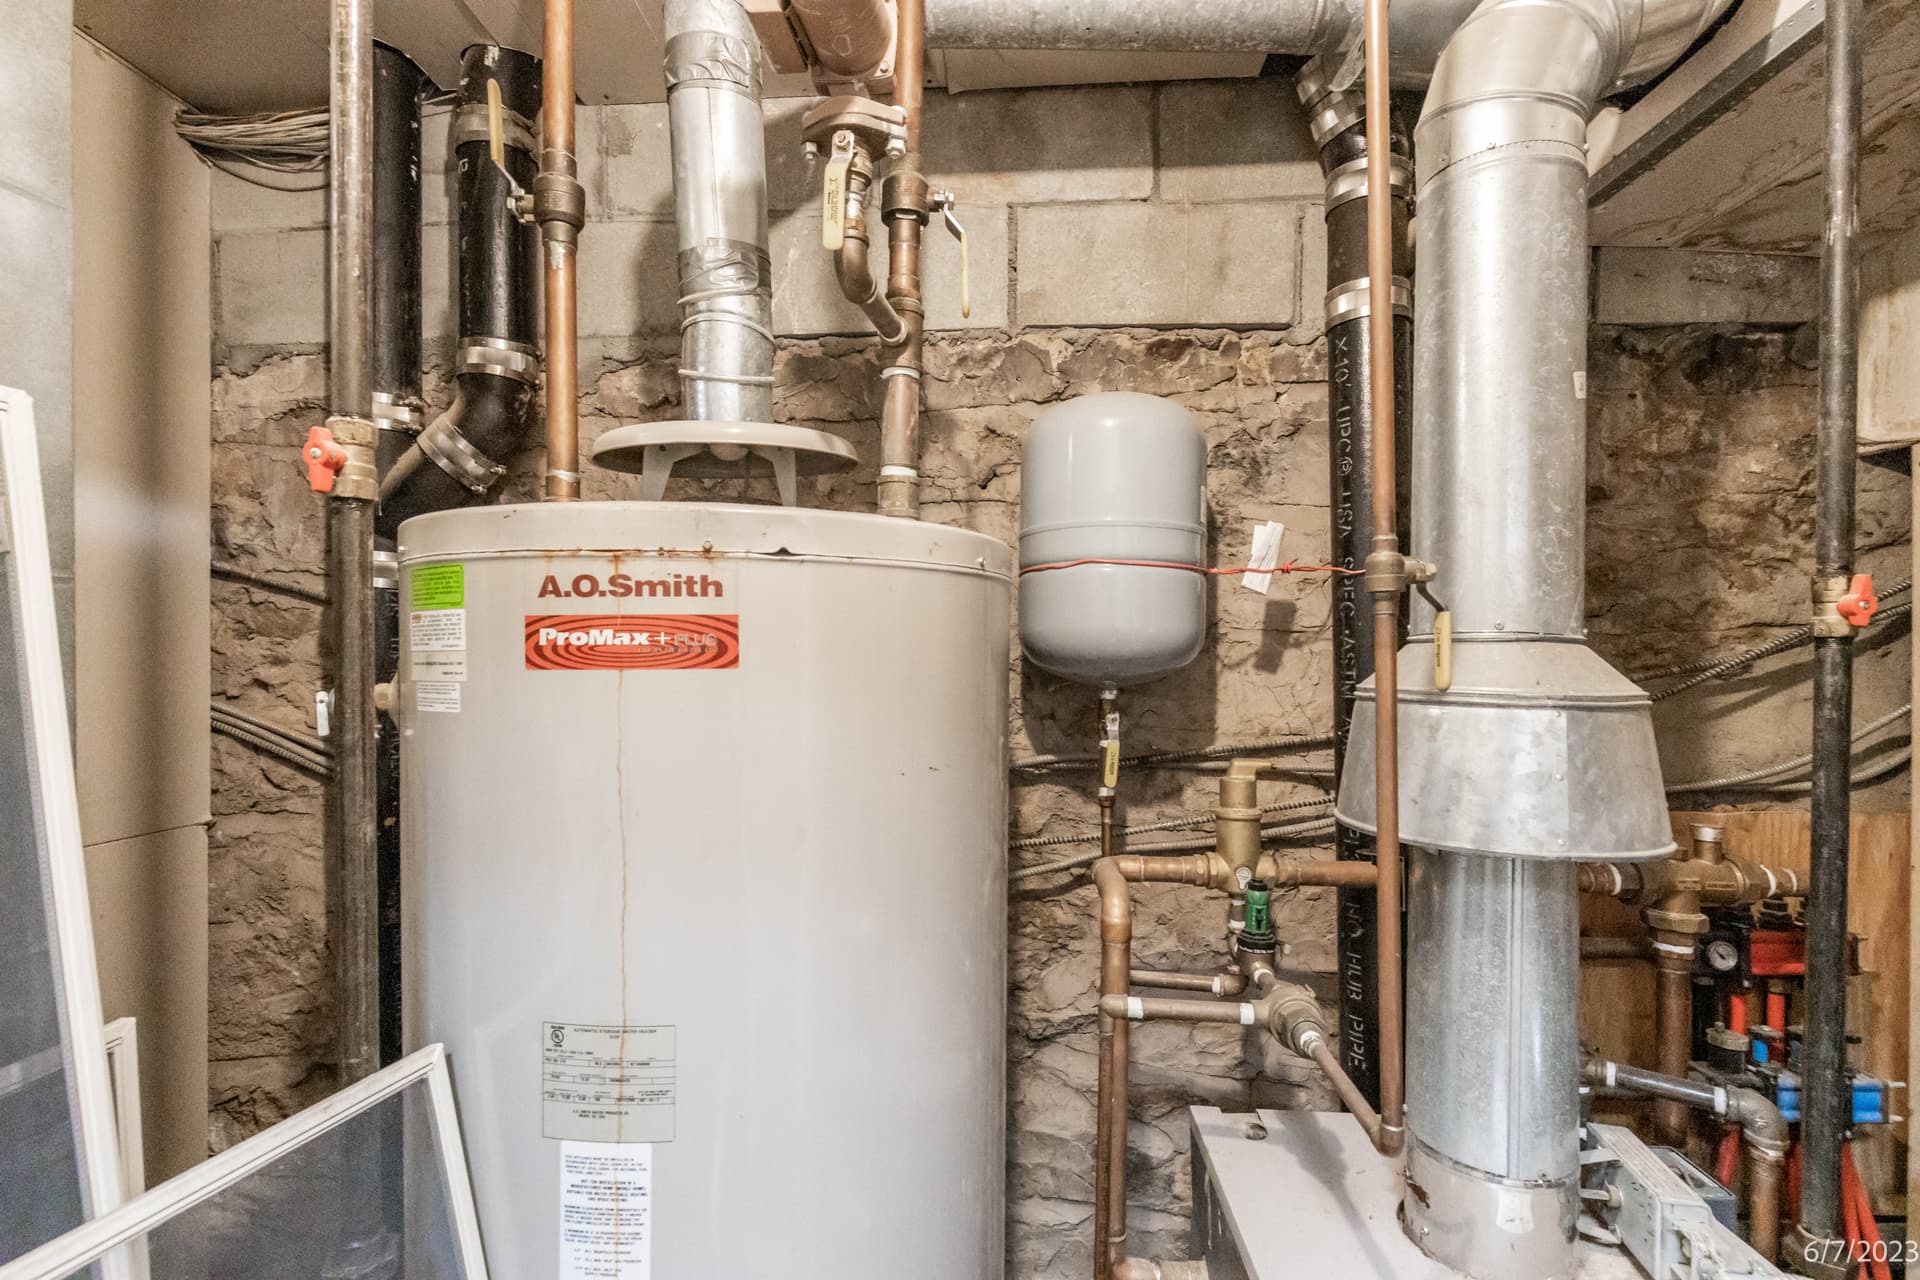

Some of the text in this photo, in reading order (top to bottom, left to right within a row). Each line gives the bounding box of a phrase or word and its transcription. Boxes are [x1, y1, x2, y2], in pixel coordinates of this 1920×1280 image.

[538, 628, 650, 646] ProMax
[1346, 952, 1362, 1001] HUB
[1347, 1014, 1367, 1070] PIPE
